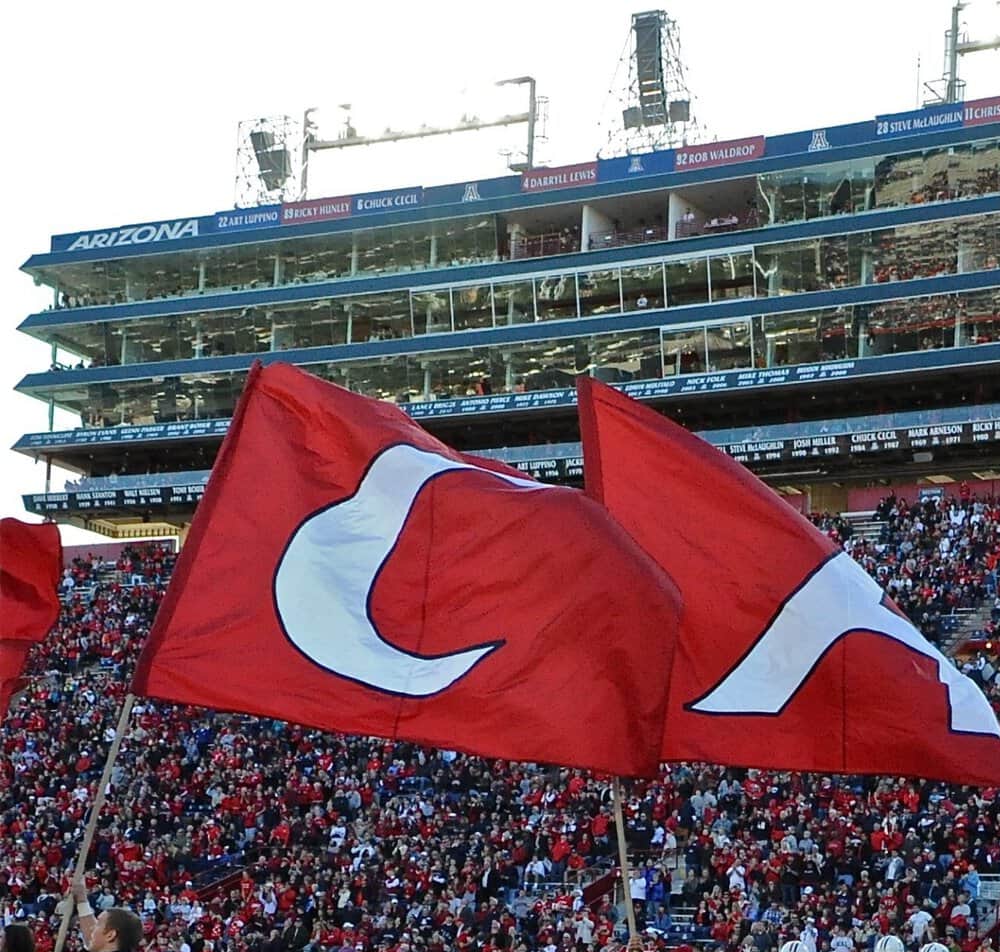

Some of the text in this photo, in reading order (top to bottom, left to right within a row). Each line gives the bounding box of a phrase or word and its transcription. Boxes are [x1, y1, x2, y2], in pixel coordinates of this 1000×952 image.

[964, 107, 973, 121] 11
[876, 121, 889, 135] 28
[889, 119, 911, 134] STEVE
[688, 151, 708, 164] ROB
[709, 144, 756, 161] WALDROP
[522, 176, 529, 188] 4
[569, 168, 597, 182] LEWIS
[364, 196, 393, 210] CHUCK
[394, 194, 418, 207] CECIL
[294, 206, 317, 218] RICKY
[319, 203, 350, 216] HUNLEY
[218, 216, 228, 228] 22
[67, 219, 199, 252] ARIZONA
[706, 375, 726, 383] FOLK
[908, 428, 928, 438] MARK
[972, 422, 993, 432] RICKY
[794, 436, 836, 449] JOSH MILLER
[851, 431, 897, 443] CHUCK CECIL
[730, 443, 746, 453] STEVE
